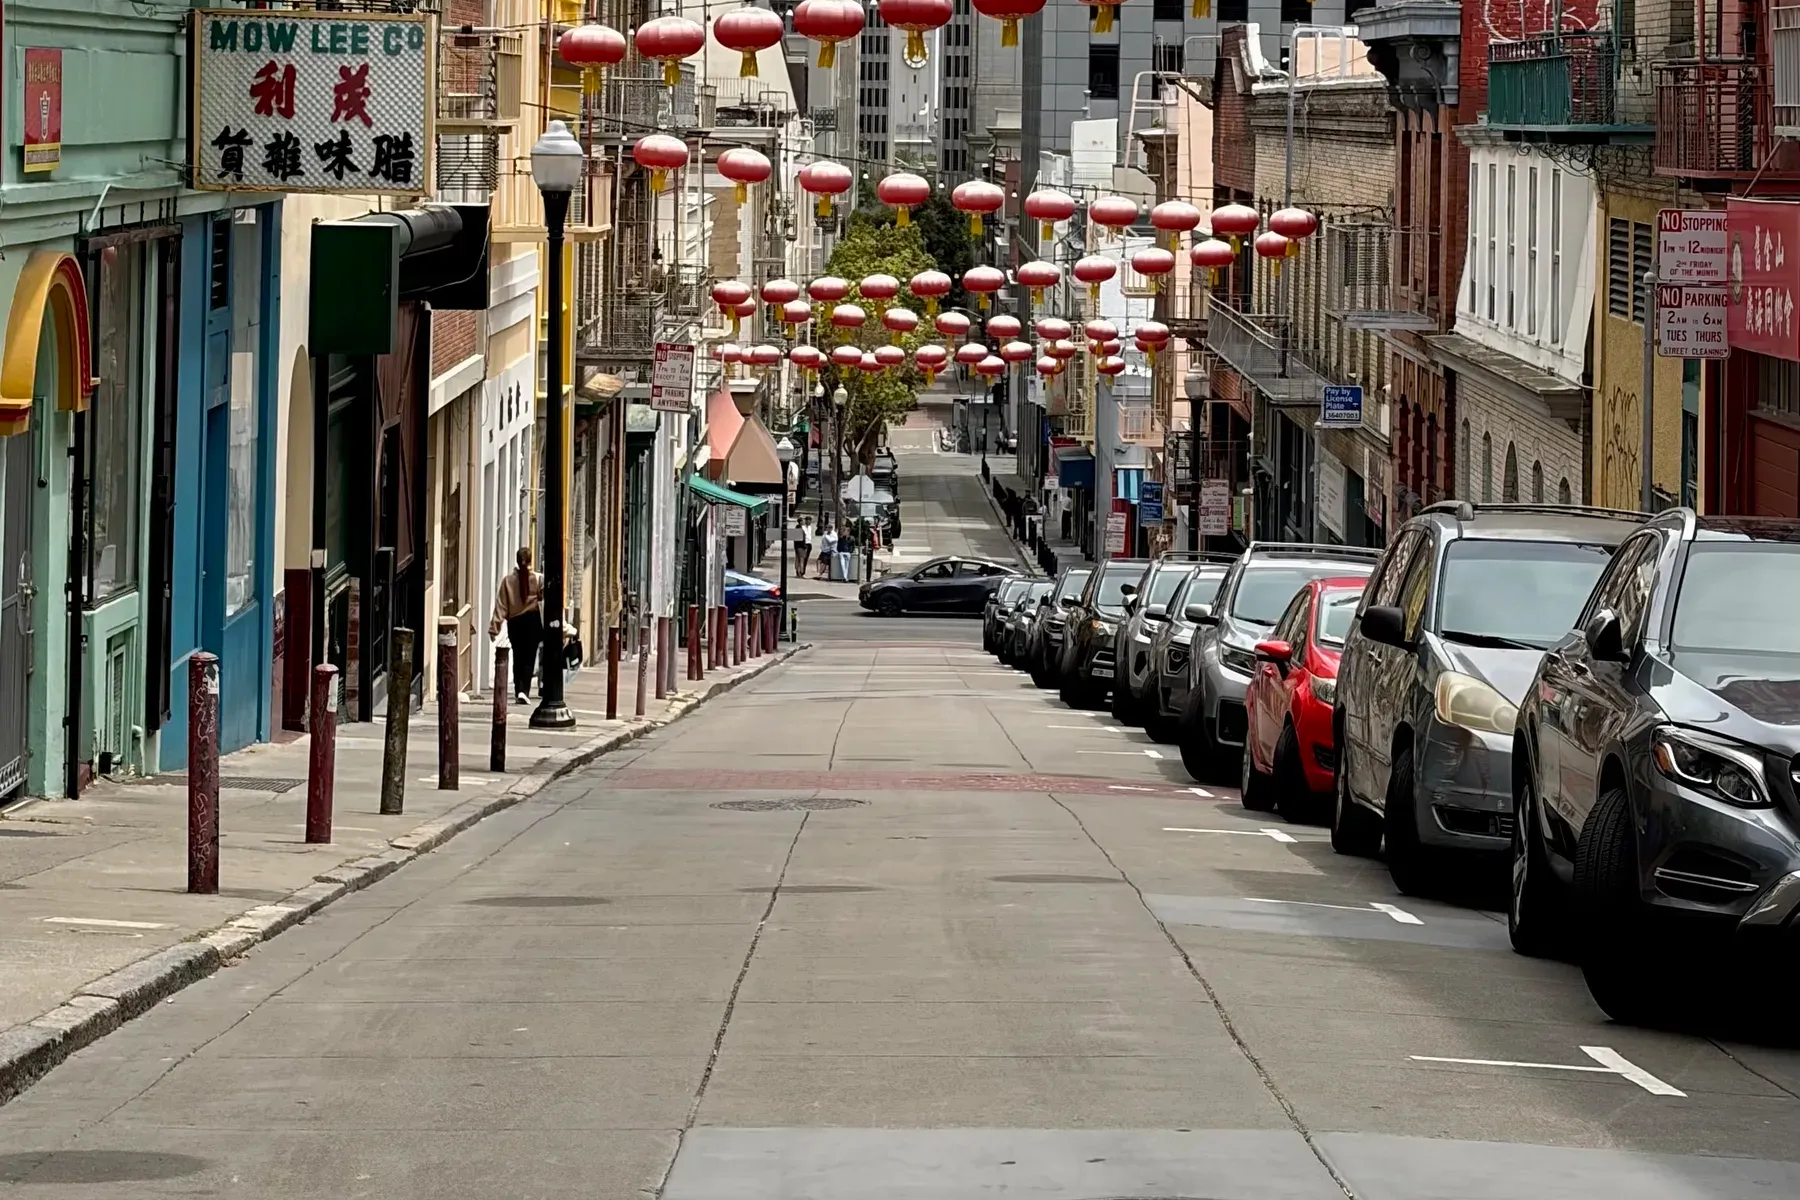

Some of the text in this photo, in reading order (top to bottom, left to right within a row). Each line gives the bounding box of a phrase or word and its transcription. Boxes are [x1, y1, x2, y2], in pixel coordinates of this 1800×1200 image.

[210, 20, 298, 53] MOW
[311, 24, 370, 55] LEE
[1662, 212, 1728, 232] NO STOPPING
[1662, 288, 1728, 307] NO PARKING
[1667, 330, 1722, 343] TUES THURS
[656, 351, 667, 361] NO
[1664, 346, 1724, 356] STREET CLEANING
[1326, 388, 1351, 396] Pay by
